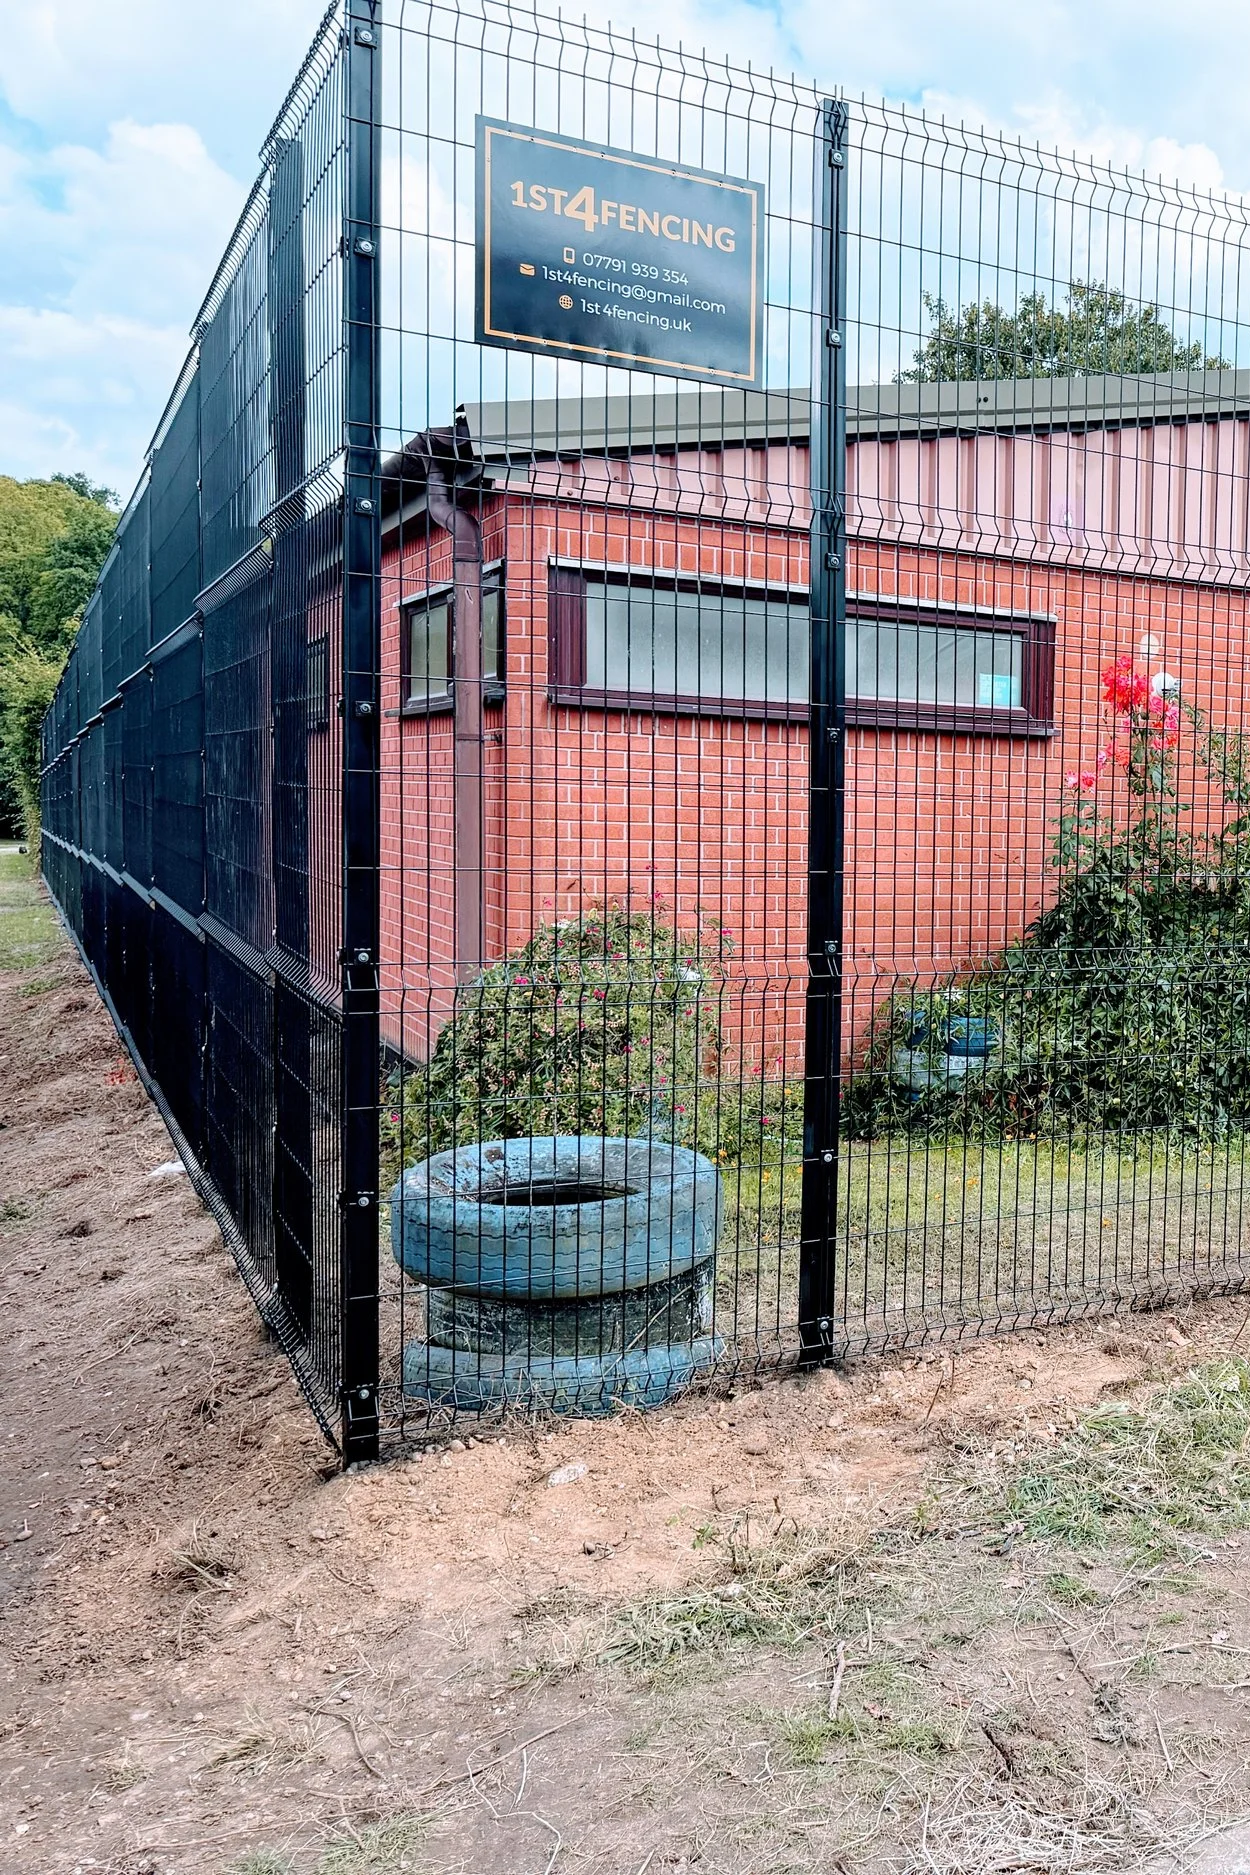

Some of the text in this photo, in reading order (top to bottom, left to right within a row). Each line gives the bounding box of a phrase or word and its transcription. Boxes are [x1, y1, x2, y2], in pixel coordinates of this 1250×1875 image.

[510, 181, 736, 253] 1ST4FENCING
[542, 265, 726, 315] 1st4fencing@gmail.com
[583, 253, 689, 286] 07791 939 354
